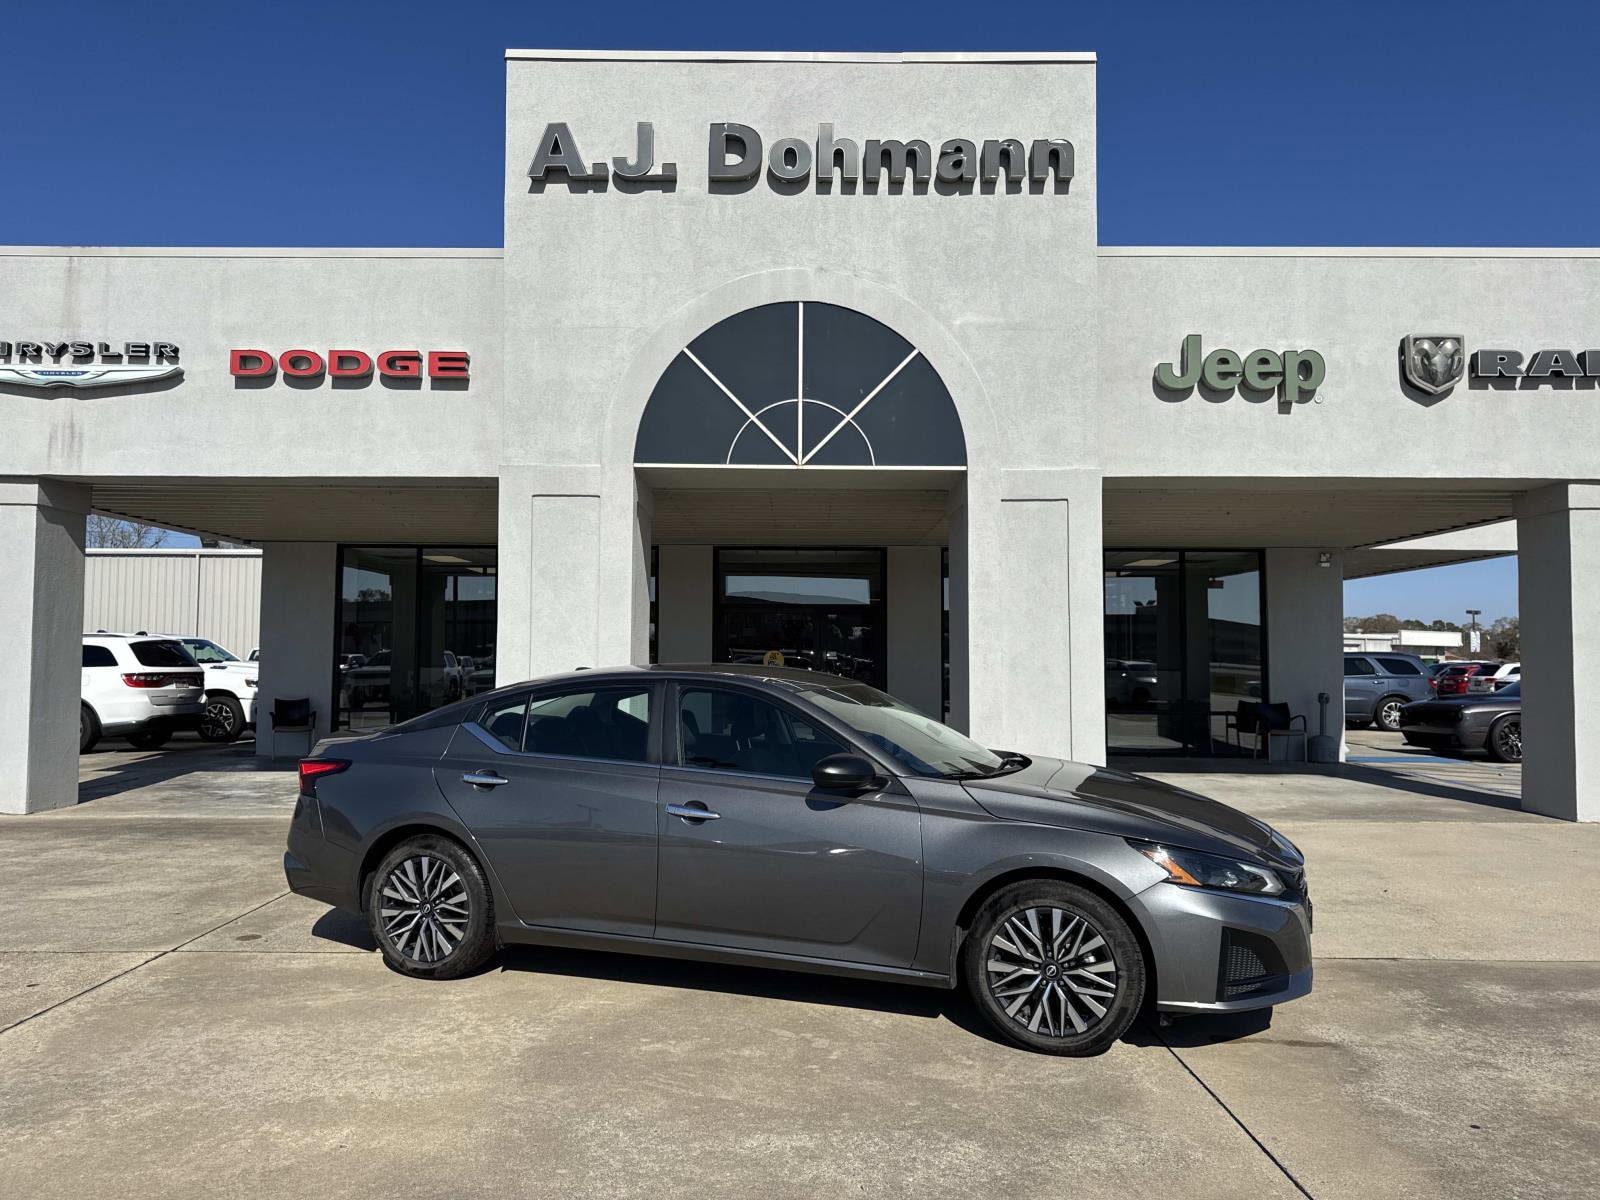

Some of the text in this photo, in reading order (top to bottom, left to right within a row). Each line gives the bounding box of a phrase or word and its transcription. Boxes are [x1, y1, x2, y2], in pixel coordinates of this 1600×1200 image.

[528, 121, 1075, 182] A.J. Dohmann
[230, 350, 469, 378] DODGE
[1156, 334, 1326, 402] Jeep
